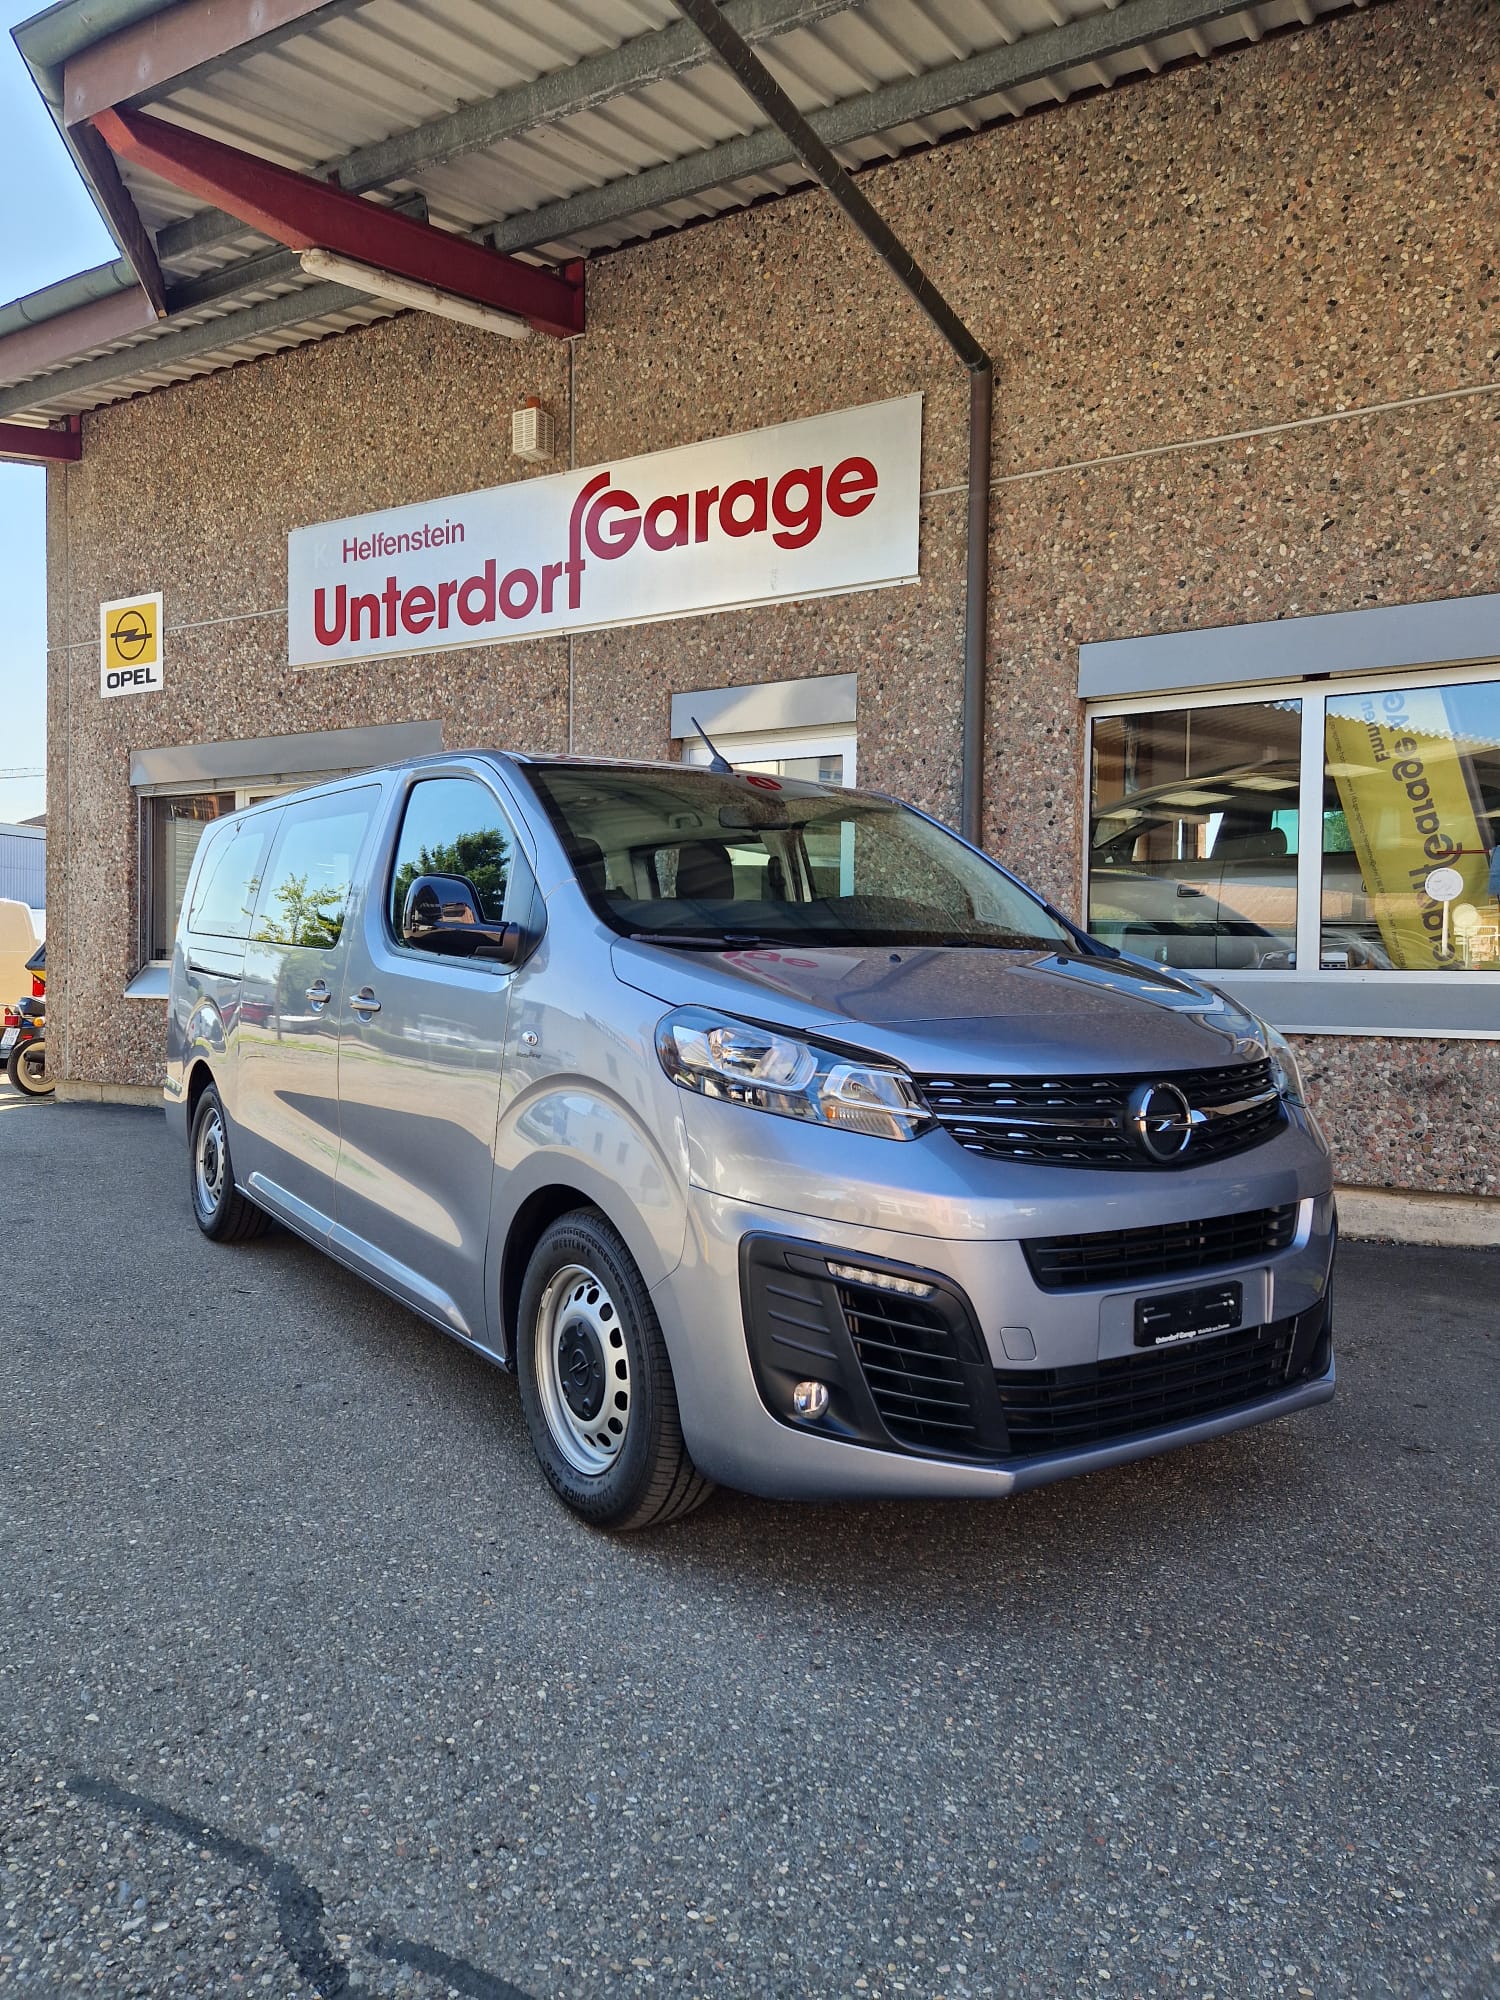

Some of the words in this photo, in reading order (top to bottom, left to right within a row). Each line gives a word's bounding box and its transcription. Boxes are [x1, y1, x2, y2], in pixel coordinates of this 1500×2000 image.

[314, 472, 611, 647] Unterdorf
[584, 456, 879, 561] Garage
[342, 518, 465, 564] Helfenstein
[106, 667, 157, 689] OPEL
